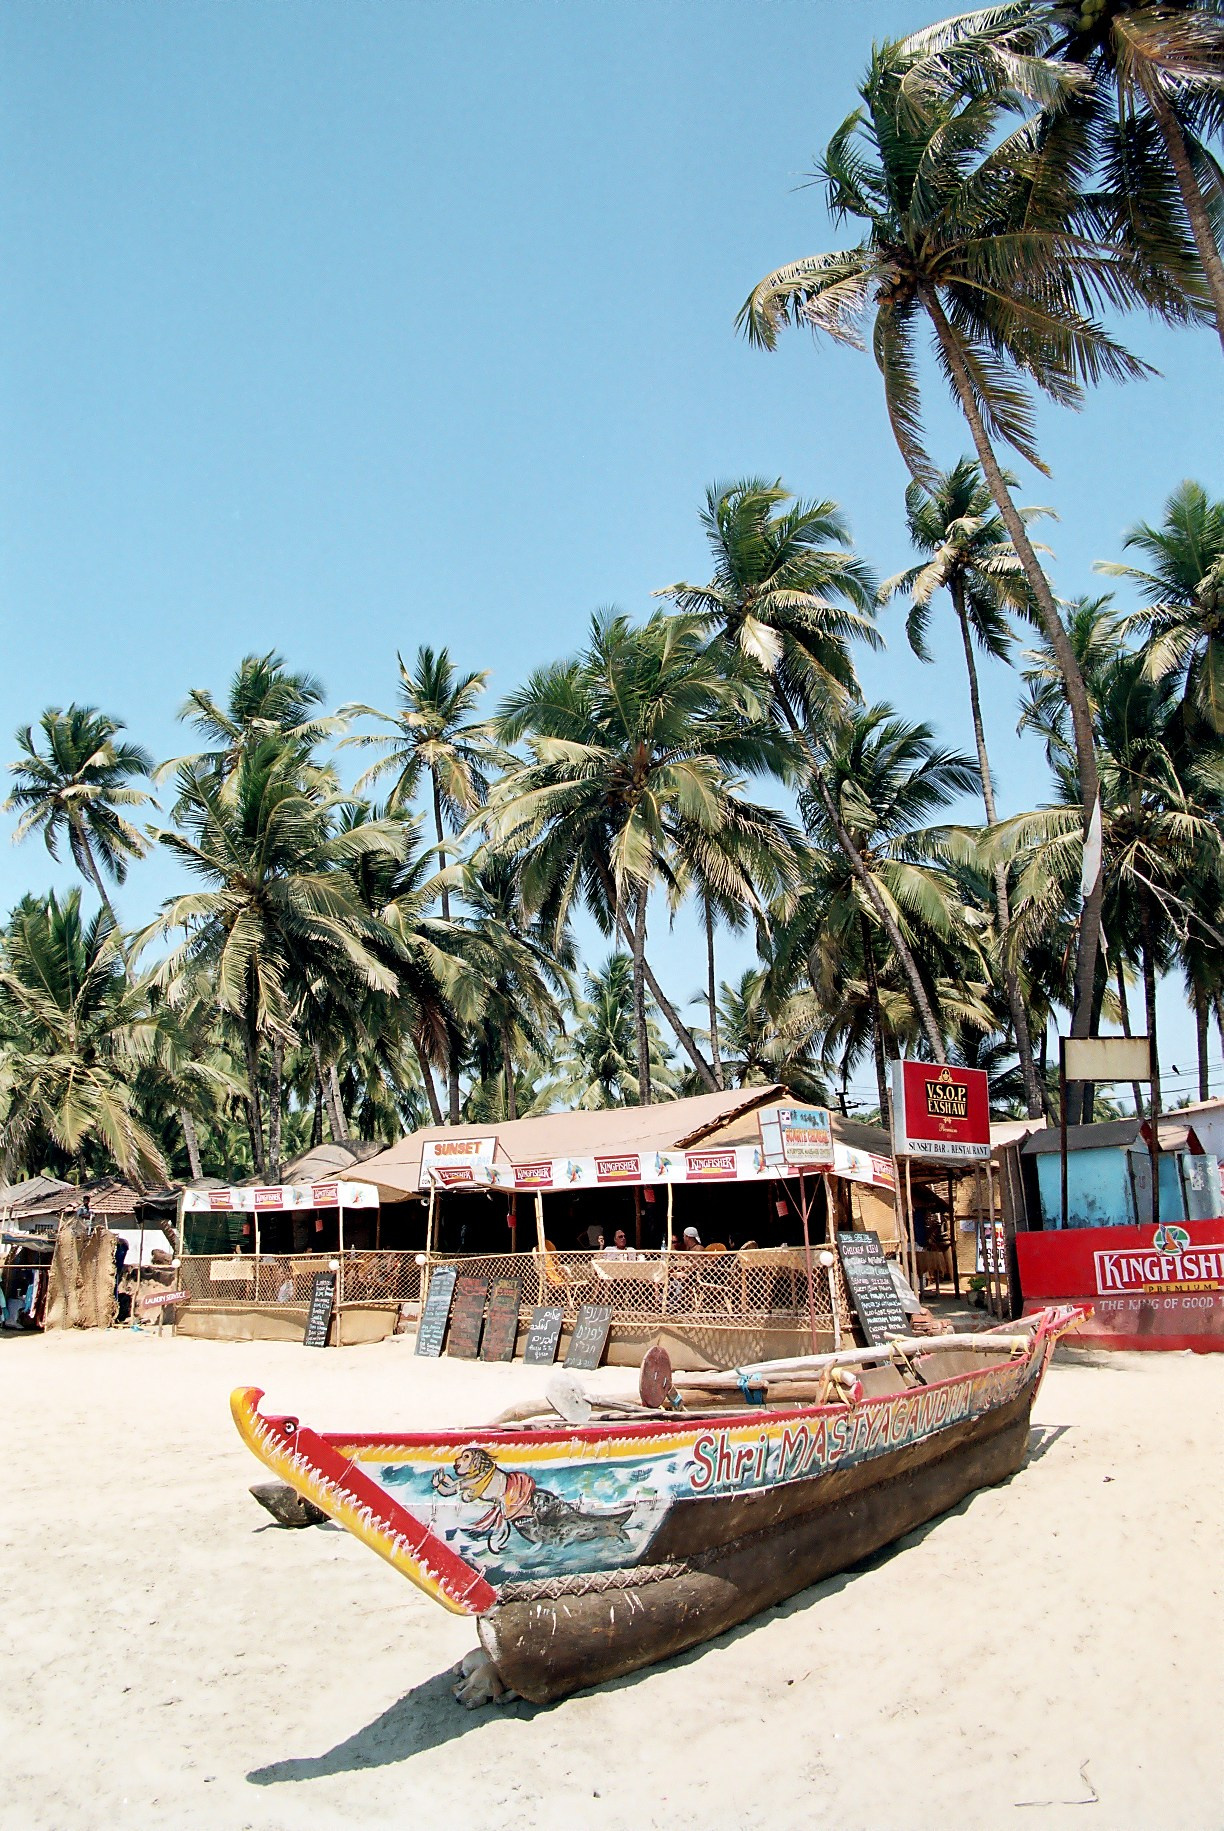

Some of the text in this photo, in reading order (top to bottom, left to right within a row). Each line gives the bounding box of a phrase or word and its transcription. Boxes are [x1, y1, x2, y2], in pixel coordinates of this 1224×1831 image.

[927, 1083, 966, 1102] V.S.O.P.
[928, 1100, 966, 1116] EXSHAW
[434, 1142, 482, 1156] SUNSET
[908, 1142, 988, 1156] SUNSET BAR RESTAURANT
[599, 1160, 638, 1174] KINGFISHER
[690, 1156, 733, 1170] KINGFISHER
[517, 1168, 549, 1179] KINGFISHER
[256, 1193, 281, 1203] KINGFISHER
[842, 1244, 879, 1255] CHICKEN KIEV
[1103, 1253, 1224, 1289] KINGFISH
[1148, 1283, 1213, 1293] PREMIUM
[1100, 1299, 1124, 1311] THE
[1129, 1298, 1160, 1310] KING
[1164, 1298, 1179, 1309] OF
[1183, 1296, 1214, 1309] GOOD
[690, 1431, 767, 1492] Shri
